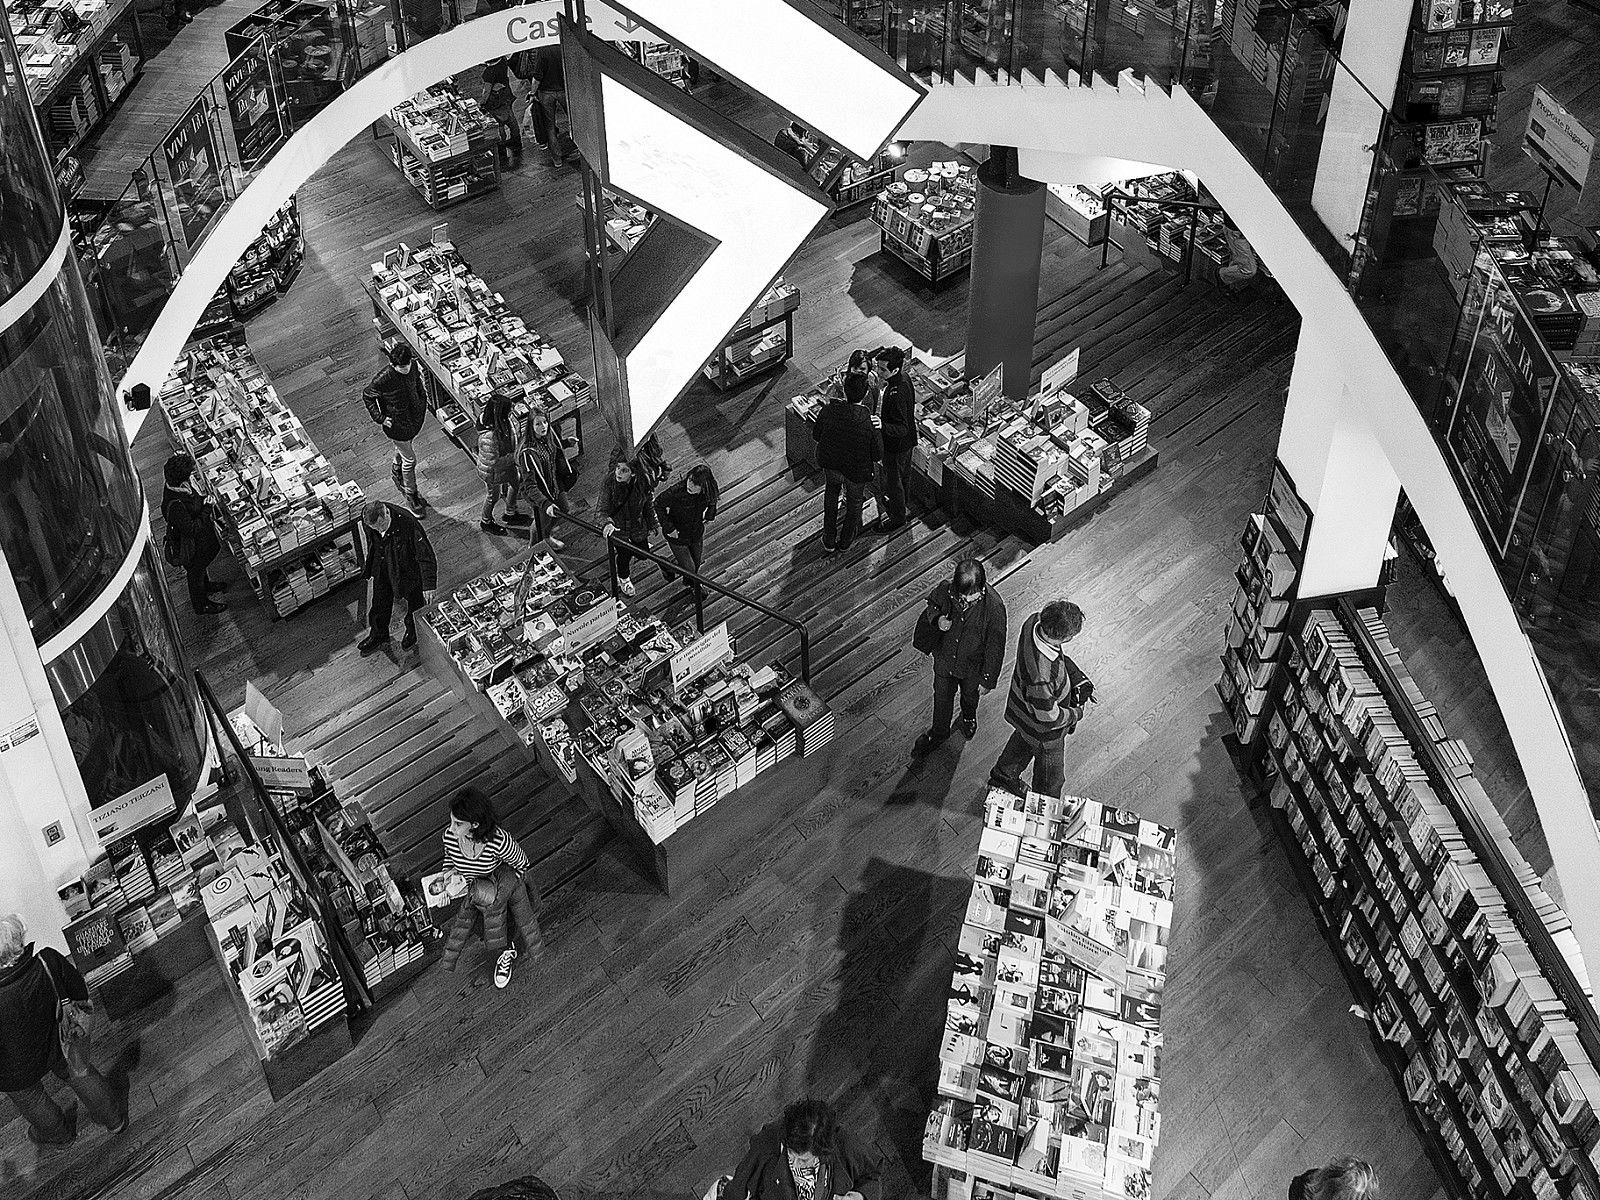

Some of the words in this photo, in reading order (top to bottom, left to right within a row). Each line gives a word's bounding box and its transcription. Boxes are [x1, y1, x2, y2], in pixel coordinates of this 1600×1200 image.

[506, 15, 593, 44] Case
[225, 73, 244, 92] VIVI
[1536, 97, 1564, 129] Proposte
[1564, 124, 1590, 153] Ragazzi
[166, 128, 188, 160] VIVI
[566, 620, 591, 638] Nuvole
[256, 766, 271, 774] ung
[92, 802, 129, 823] TIZIANO
[128, 782, 166, 805] TERZANI
[1056, 924, 1081, 940] Giulio
[1082, 937, 1112, 957] Einaudi
[1071, 938, 1099, 955] editore
